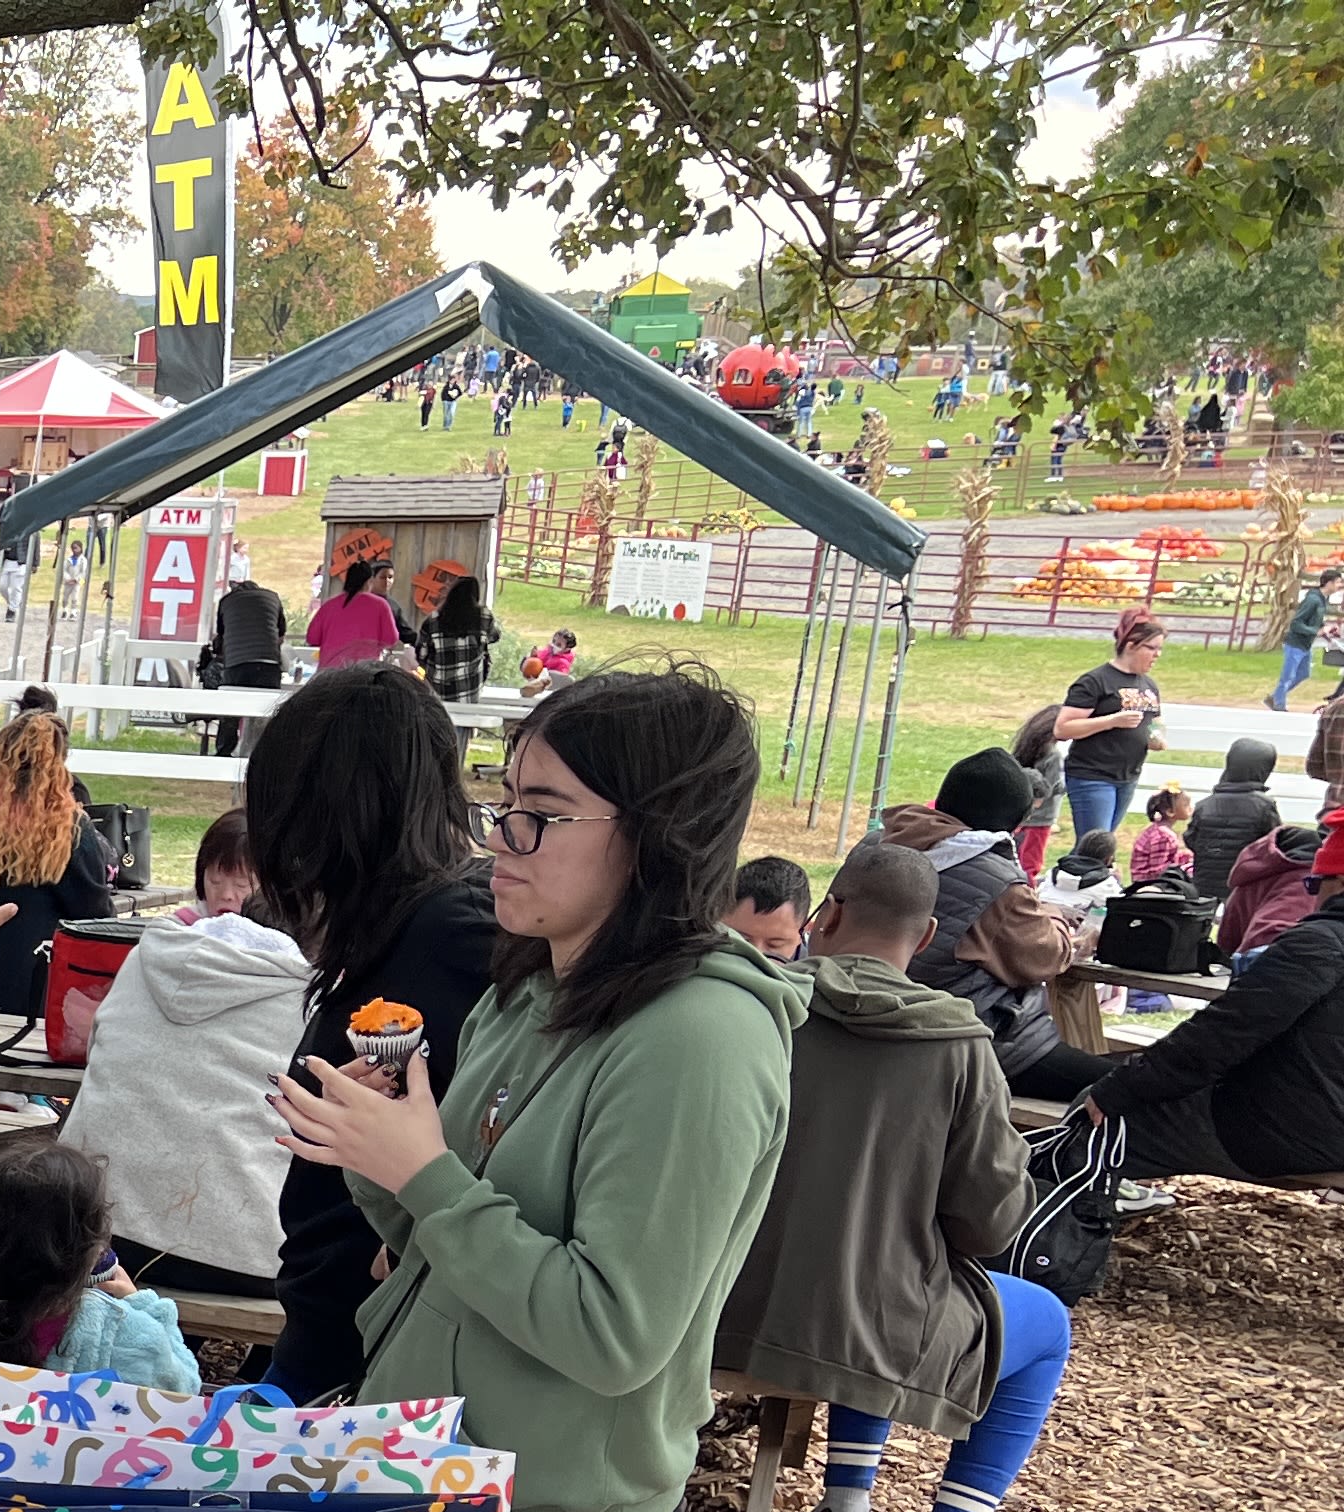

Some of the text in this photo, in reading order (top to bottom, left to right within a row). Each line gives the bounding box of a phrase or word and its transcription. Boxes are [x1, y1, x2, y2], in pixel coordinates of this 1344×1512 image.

[151, 61, 220, 326] ATM
[159, 509, 201, 525] ATM
[622, 541, 700, 564] The Life of a Pumpkin
